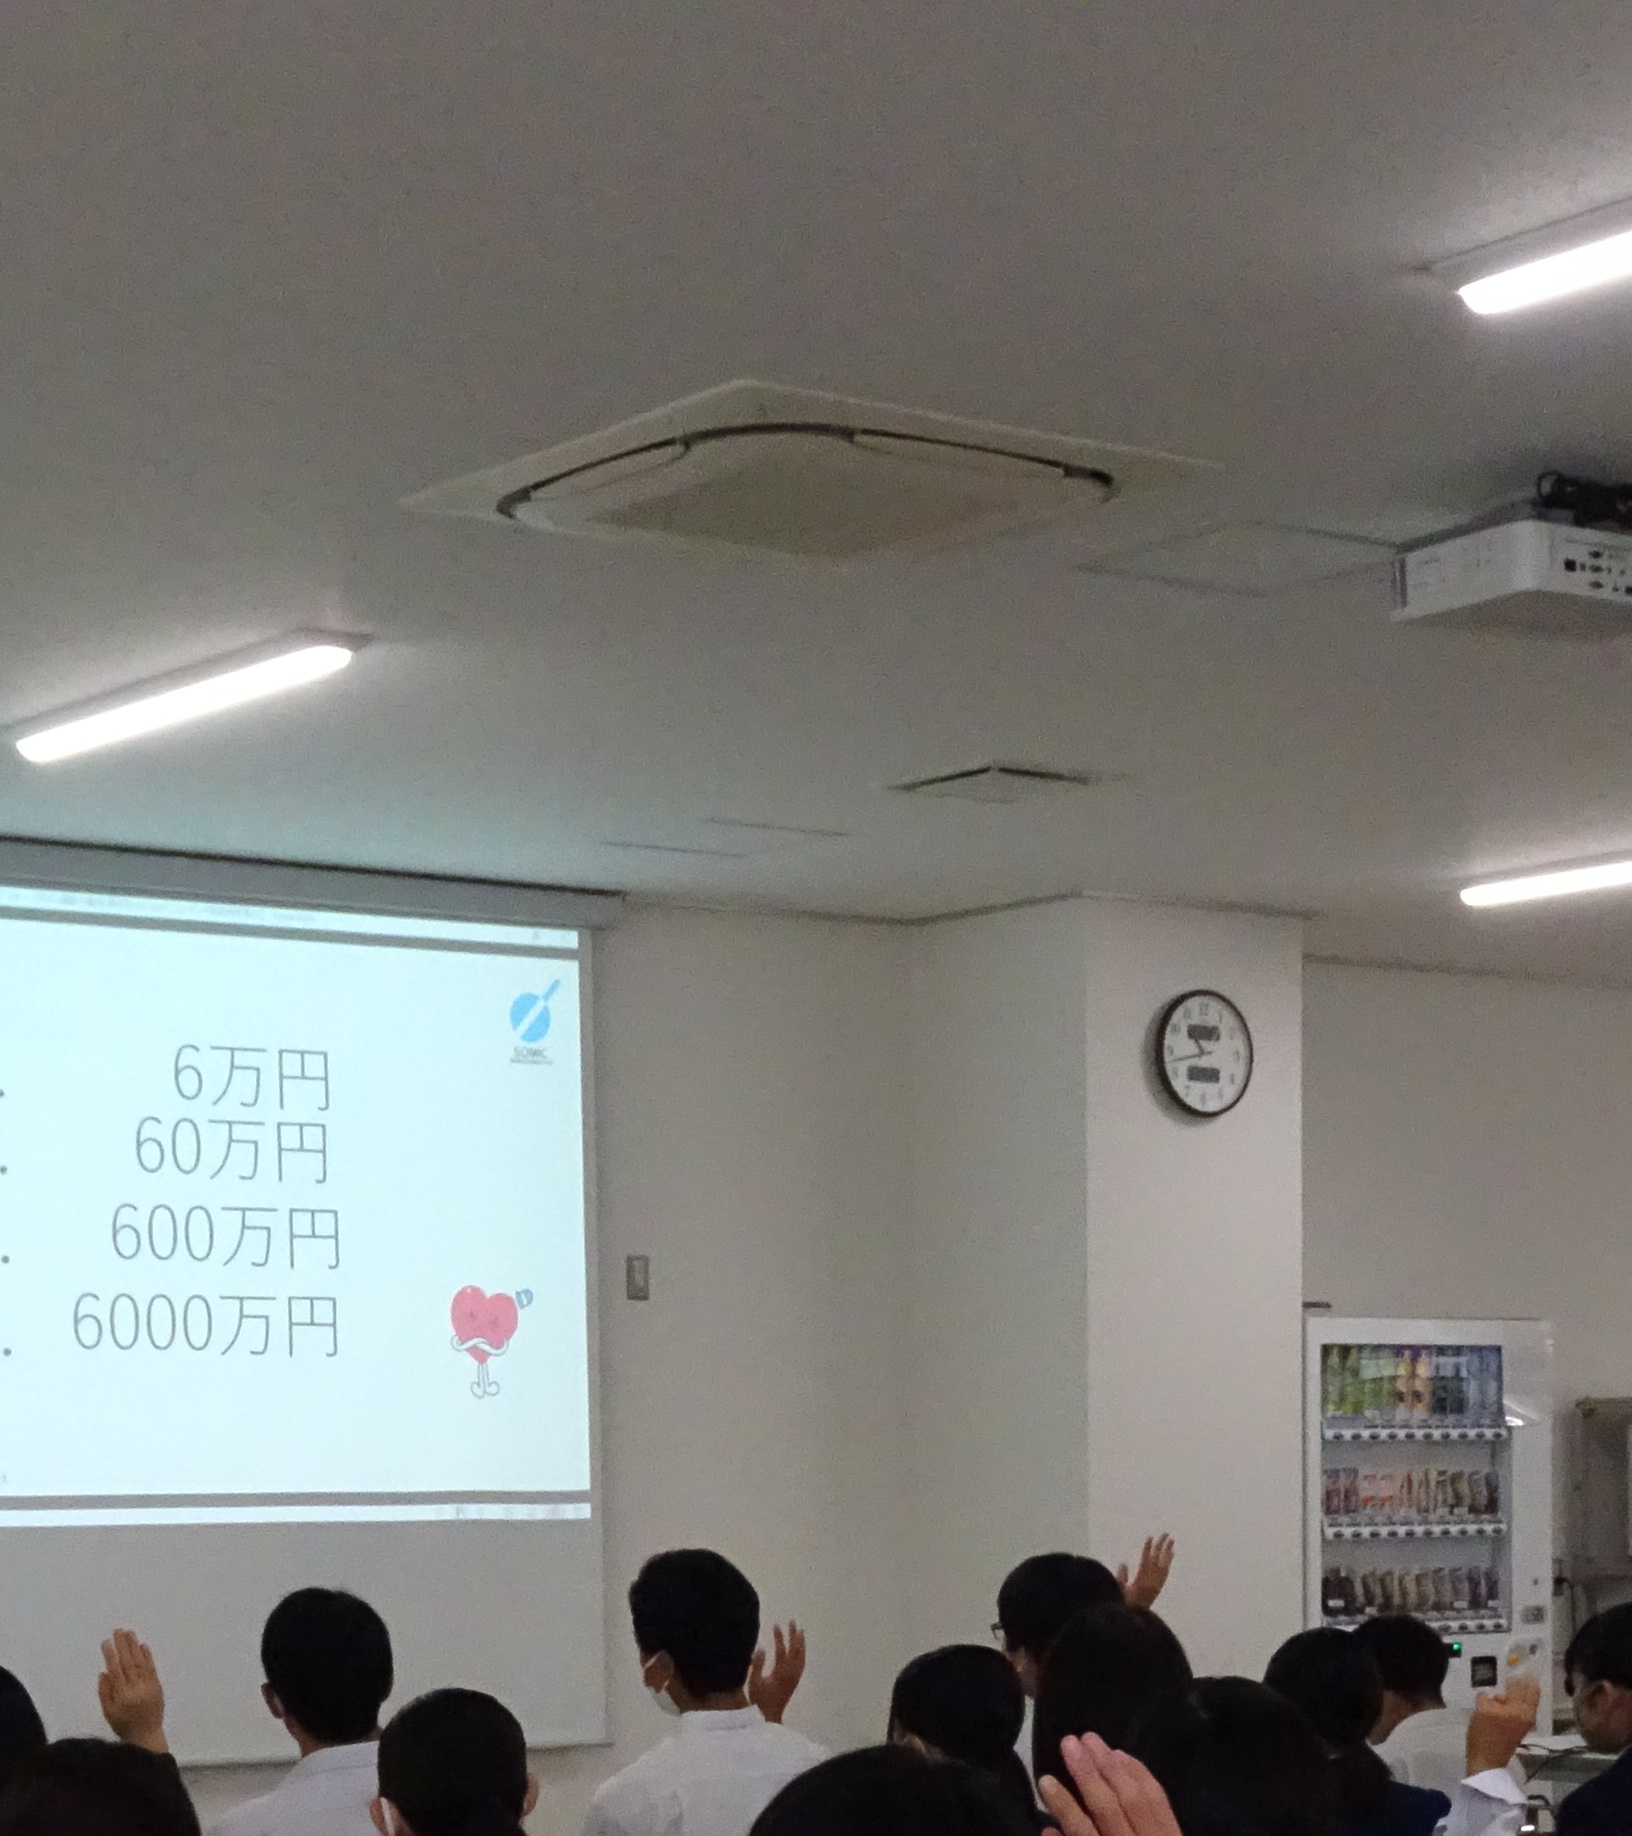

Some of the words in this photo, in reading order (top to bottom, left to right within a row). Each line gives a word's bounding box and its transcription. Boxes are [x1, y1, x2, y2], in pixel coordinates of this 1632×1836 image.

[174, 1044, 330, 1112] 6万円
[135, 1116, 328, 1184] 60万円
[112, 1203, 340, 1270] 600万円
[72, 1292, 339, 1358] 6000万円
